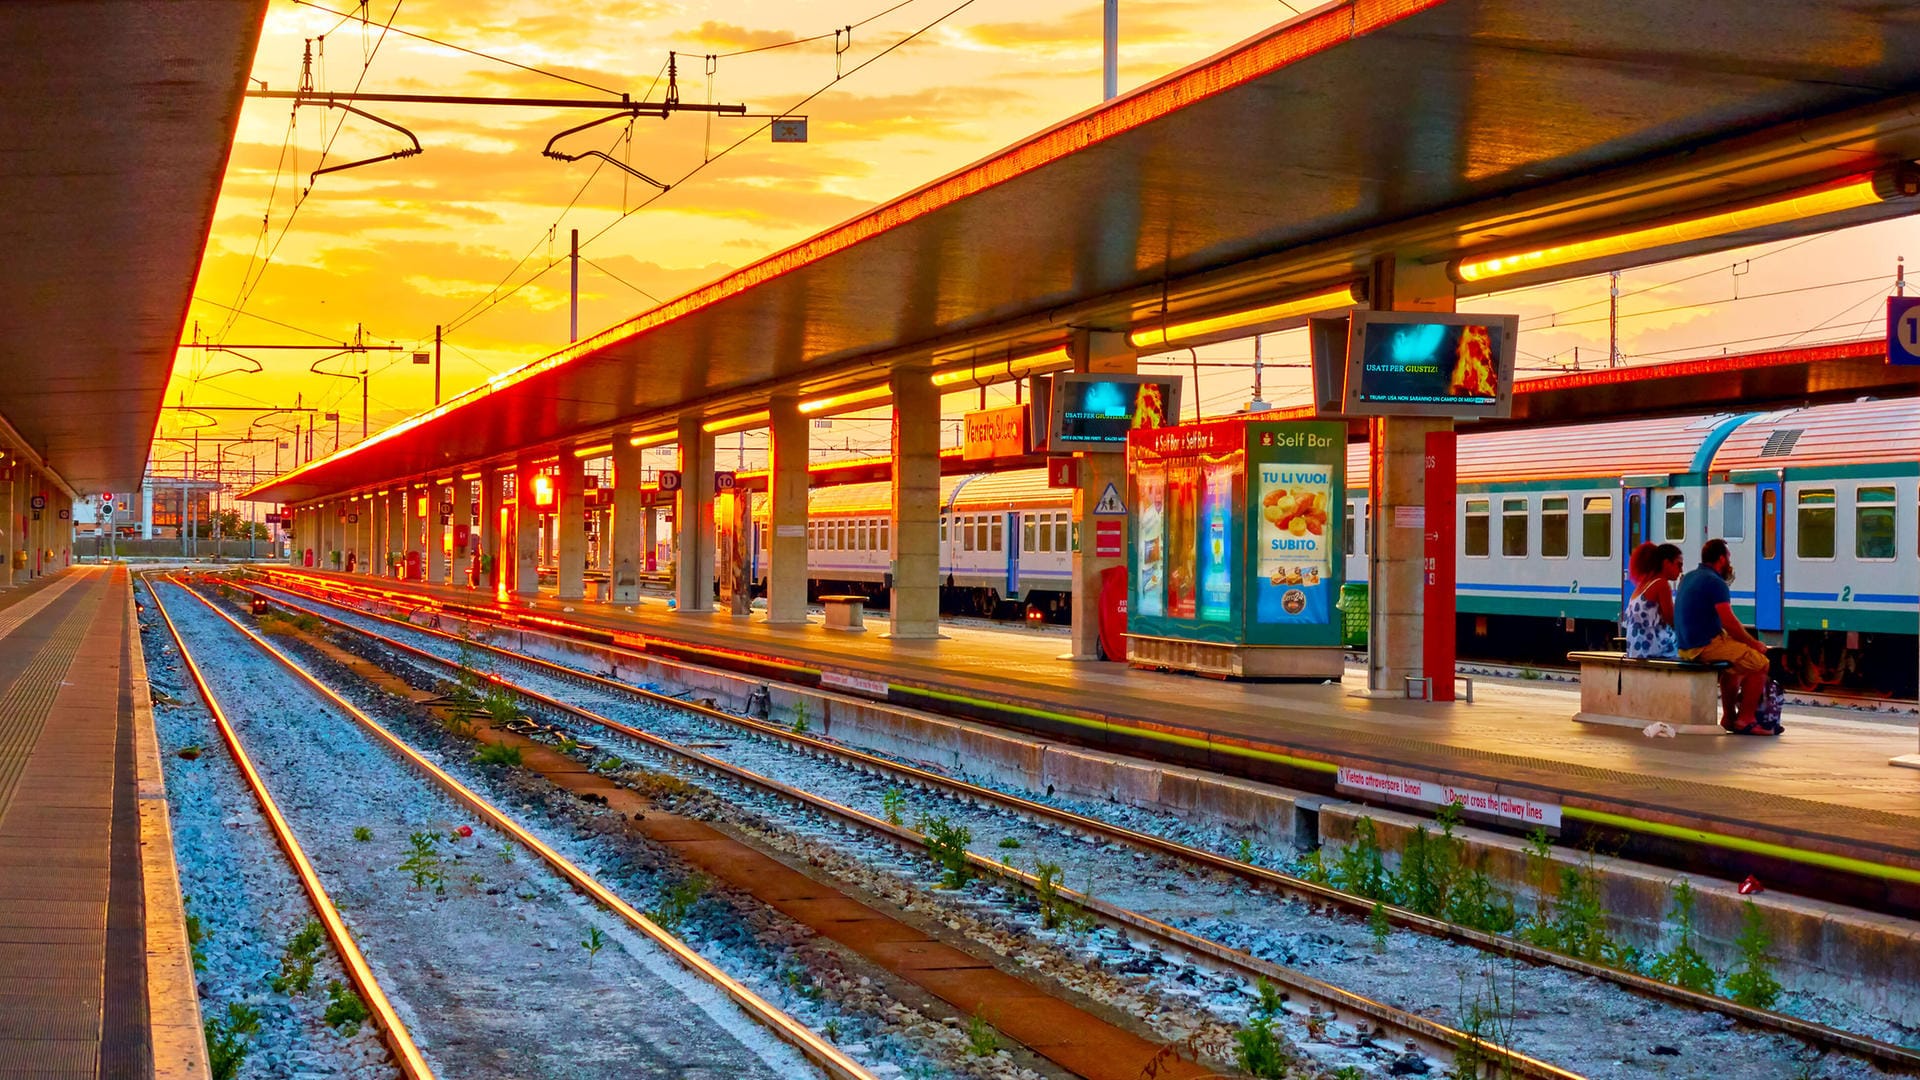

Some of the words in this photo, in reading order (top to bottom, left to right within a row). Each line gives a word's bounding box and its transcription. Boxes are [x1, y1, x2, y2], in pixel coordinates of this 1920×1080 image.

[1366, 364, 1389, 372] USATI
[1390, 364, 1404, 372] PER
[1186, 430, 1197, 449] Self
[1197, 431, 1208, 448] Bar
[1277, 432, 1305, 447] Self
[1308, 433, 1333, 447] Bar
[664, 476, 674, 485] 11
[720, 478, 732, 487] 10
[1262, 472, 1278, 483] TU
[1281, 472, 1293, 484] LI
[1571, 579, 1578, 593] 2
[1842, 585, 1851, 602] 2
[1346, 769, 1364, 785] Vietato
[1366, 775, 1400, 792] attraversare
[1404, 777, 1422, 796] binari
[1471, 795, 1486, 809] cross
[1488, 794, 1498, 811] the
[1501, 798, 1525, 820] railway
[1526, 801, 1543, 820] lines
